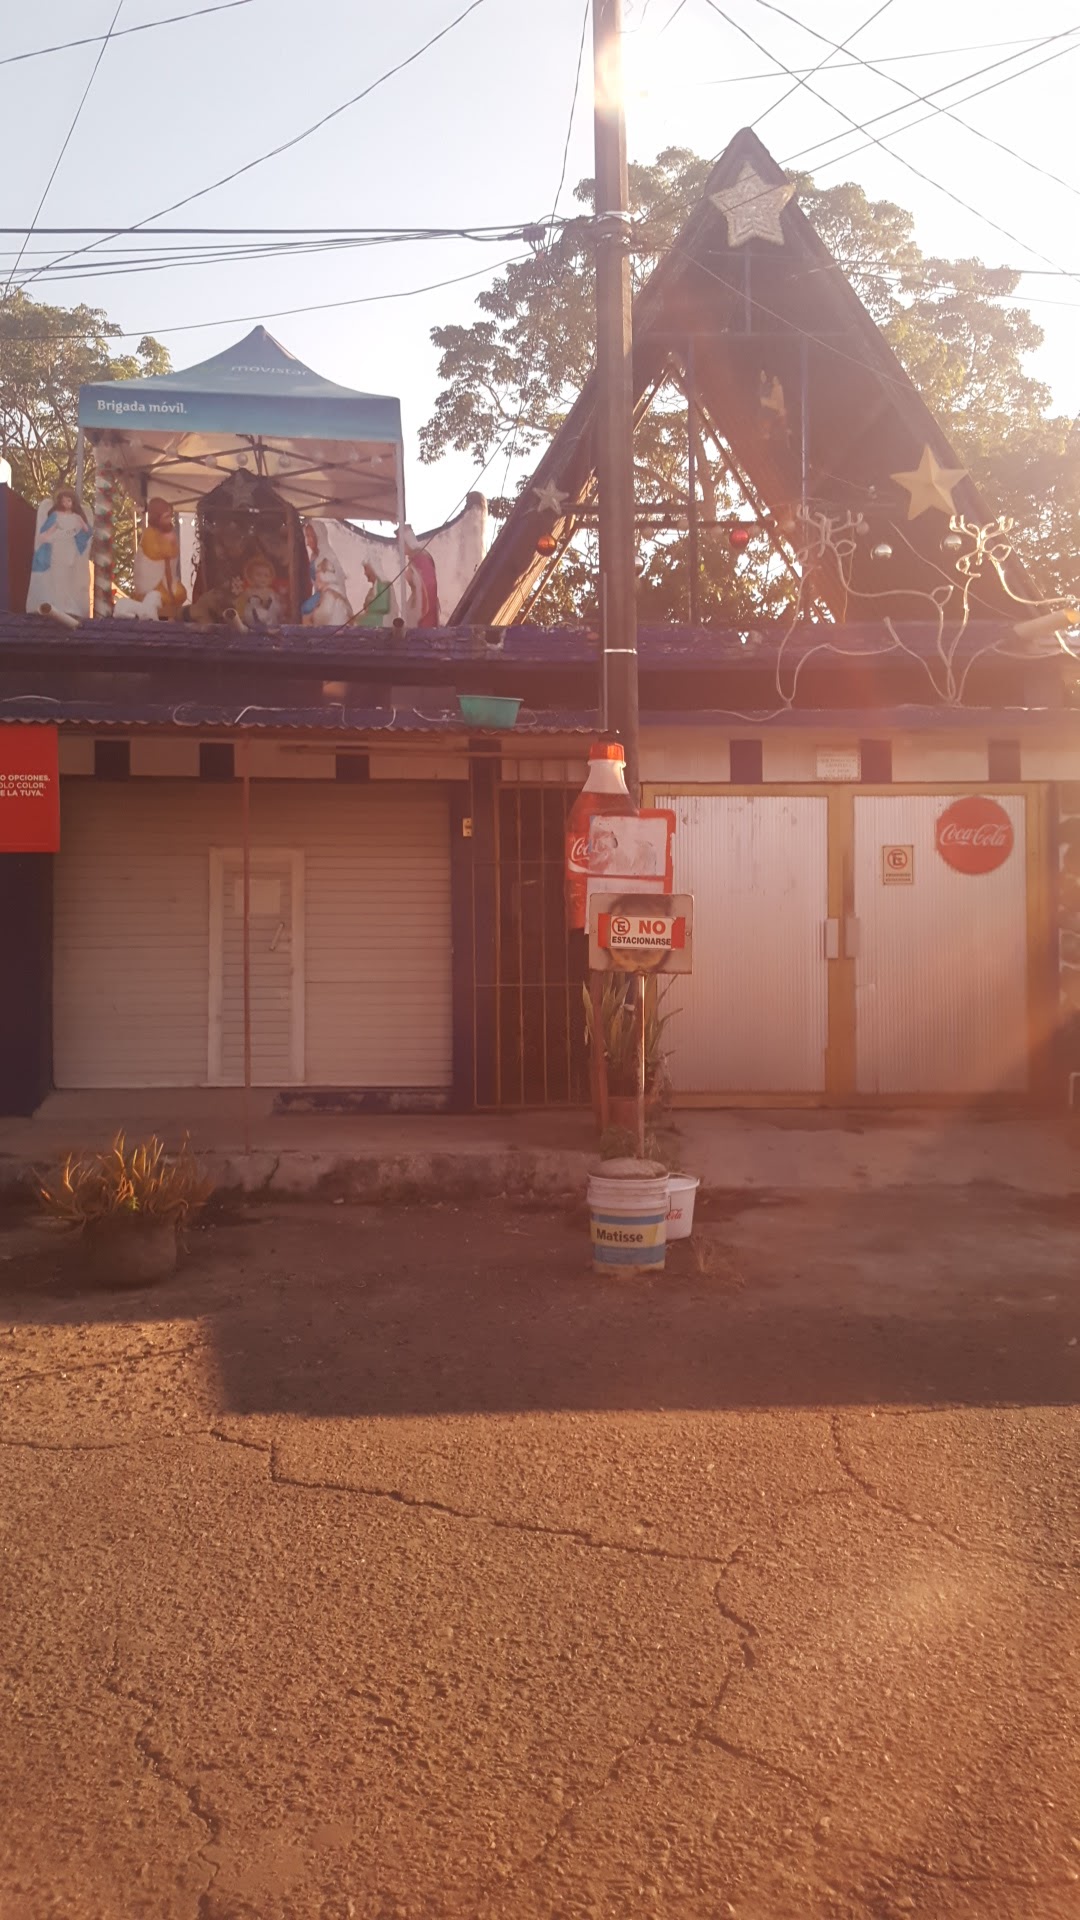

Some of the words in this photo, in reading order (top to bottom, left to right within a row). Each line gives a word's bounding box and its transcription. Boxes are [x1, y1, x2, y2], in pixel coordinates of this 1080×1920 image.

[231, 365, 308, 376] movistar
[97, 400, 145, 414] Brigada
[149, 401, 187, 414] móvil.
[8, 774, 51, 782] OPCIONES.
[7, 789, 18, 797] LA
[20, 789, 44, 797] TUYA.
[638, 920, 666, 935] NO
[612, 936, 671, 946] ESTACIONARSE
[596, 1228, 643, 1243] Matisse
